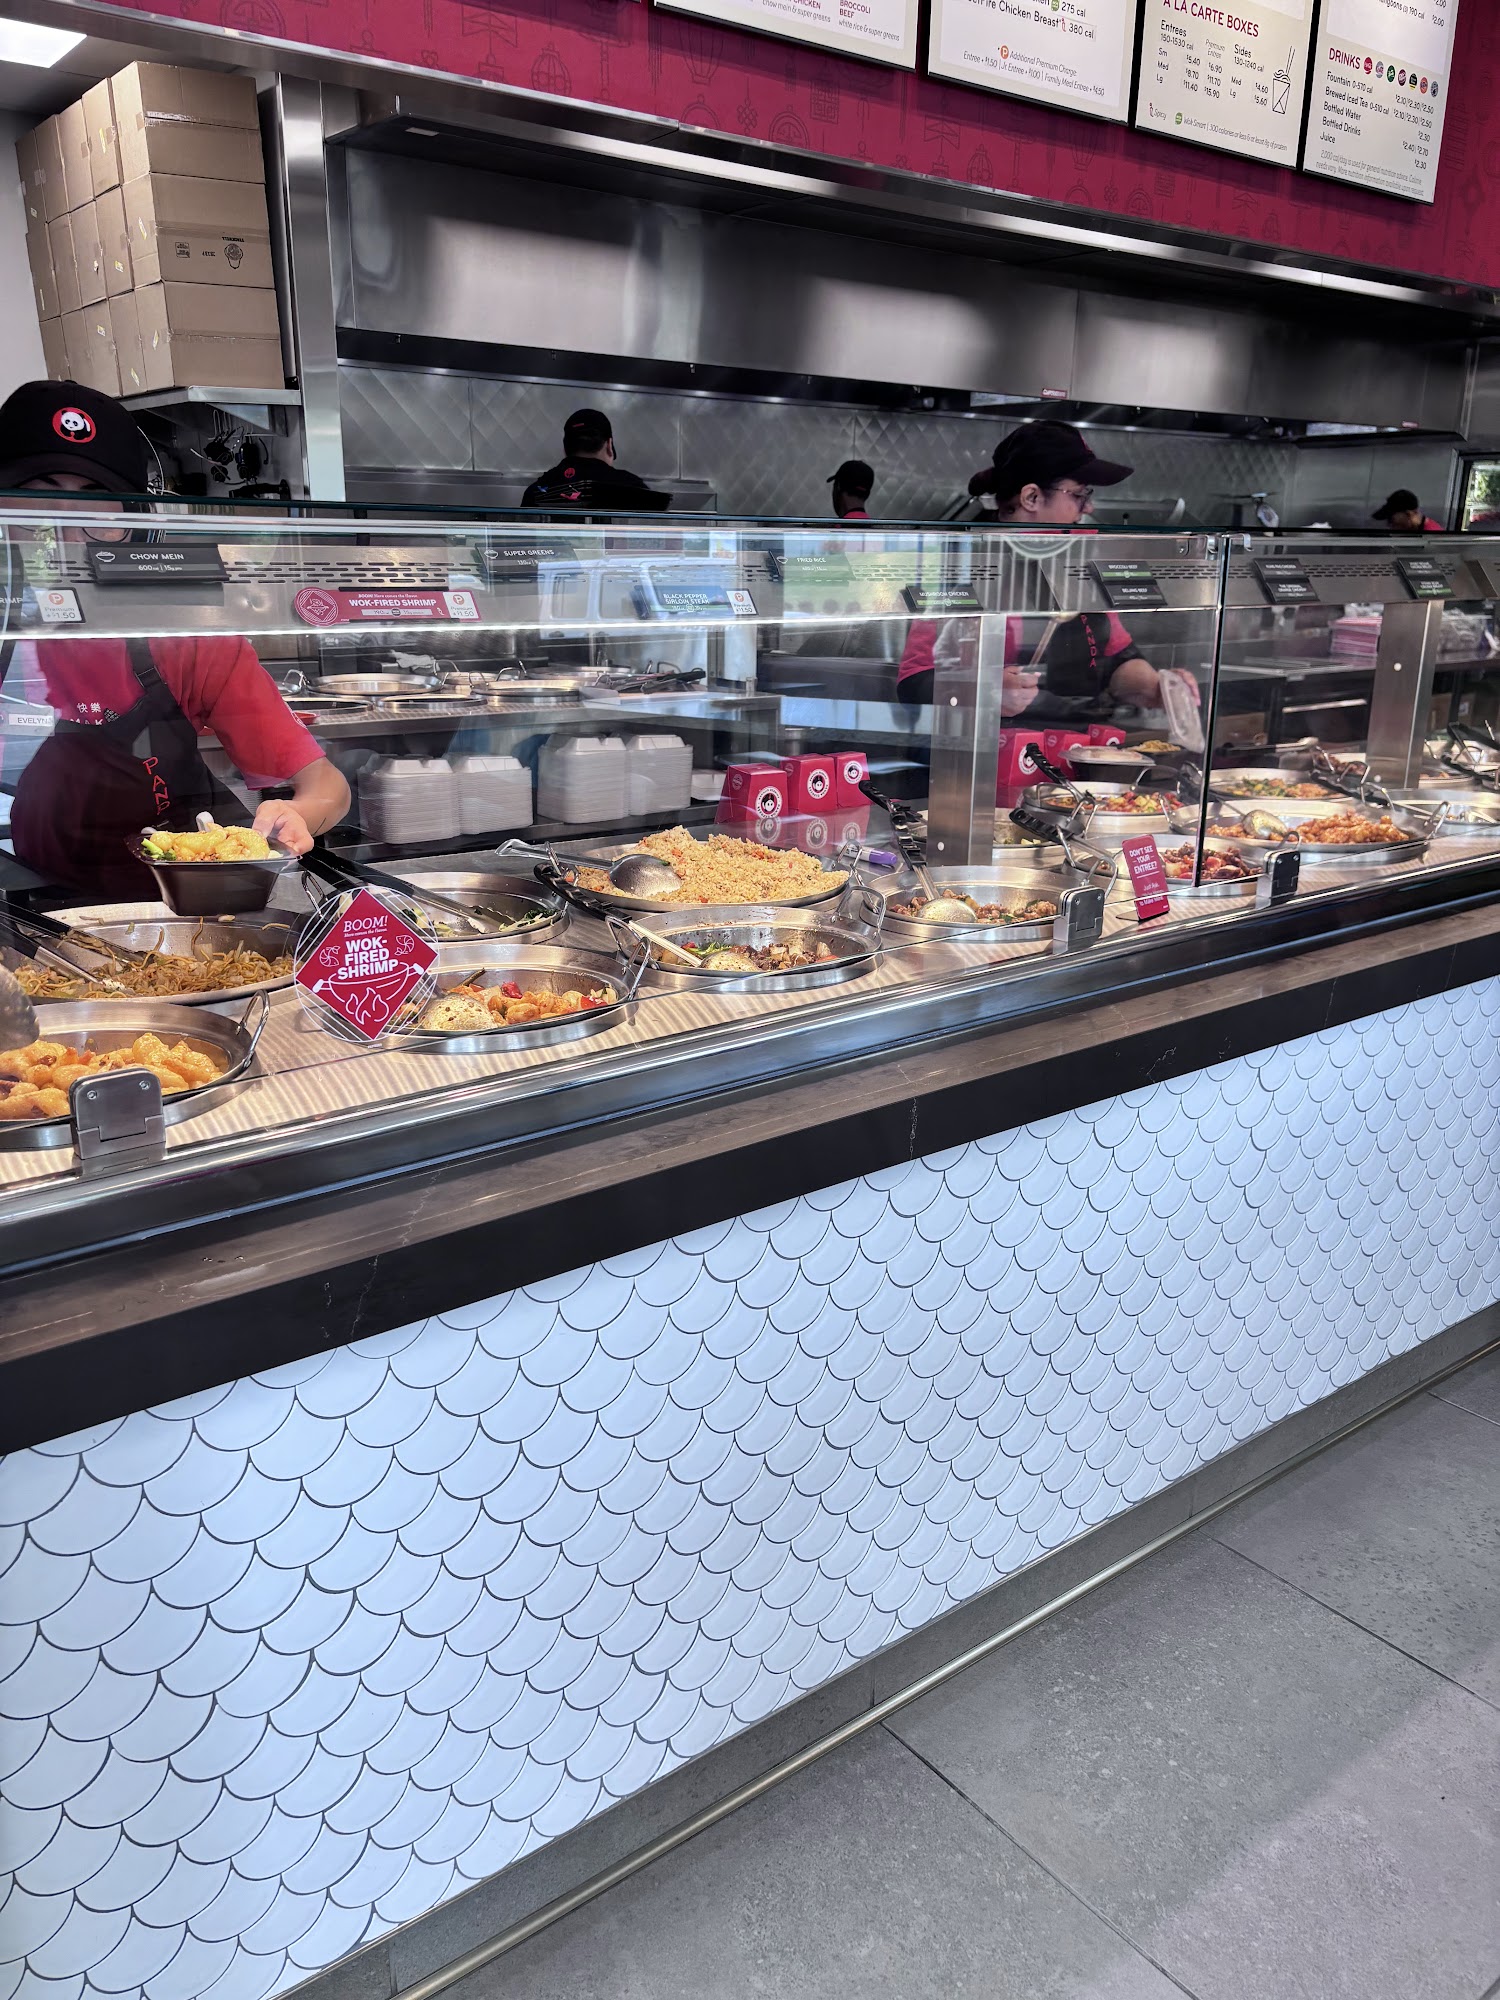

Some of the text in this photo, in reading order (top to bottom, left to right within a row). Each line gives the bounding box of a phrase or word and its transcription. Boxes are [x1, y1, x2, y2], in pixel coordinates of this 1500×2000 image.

[797, 8, 812, 17] super
[839, 0, 871, 14] BROCCOLI
[839, 8, 855, 19] BEEF
[1061, 2, 1075, 14] 275
[1076, 8, 1086, 18] cal
[999, 0, 1031, 19] Chicken
[1068, 23, 1083, 35] 380
[1084, 29, 1094, 39] cal
[1174, 0, 1188, 14] LA
[1191, 2, 1224, 26] CARTE
[1226, 15, 1259, 37] BOXES
[1432, 14, 1445, 27] $2.00
[852, 22, 863, 31] rice
[868, 27, 882, 37] super
[882, 31, 900, 41] greens
[1160, 20, 1187, 37] Entrees
[1186, 43, 1194, 51] cal
[1234, 44, 1252, 58] Sides
[963, 51, 981, 63] Entree
[1007, 63, 1024, 75] Entree
[1009, 51, 1058, 71] Additional Premium
[1158, 47, 1223, 74] Sm $5.40 $6.90
[1234, 56, 1265, 73] 130-1240 cal
[1329, 47, 1361, 70] DRINKS
[1157, 61, 1169, 71] Med
[1185, 67, 1199, 80] $8.70
[1327, 70, 1351, 87] Fountain
[1156, 73, 1164, 84] Lg
[1183, 80, 1199, 92] $11.40
[1231, 76, 1269, 94] Med $4.60
[1229, 88, 1237, 98] Lg
[1325, 86, 1346, 101] Brewed
[1346, 92, 1359, 105] Iced
[1359, 97, 1368, 108] Tea
[1323, 101, 1344, 116] Bottled
[1345, 108, 1361, 121] Water
[1322, 116, 1343, 131] Bottled
[1343, 122, 1361, 136] Drinks
[1319, 131, 1336, 144] Juice
[349, 599, 401, 607] WOK-FIRED
[1080, 614, 1097, 668] PANDA
[1129, 845, 1153, 857] DON'T SEE
[1136, 854, 1150, 864] YOUR
[1133, 861, 1158, 874] ENTREE?
[343, 915, 388, 932] BOOM!
[345, 935, 388, 953] WOK-
[344, 948, 390, 966] FIRED
[337, 958, 398, 980] SHRIMP
